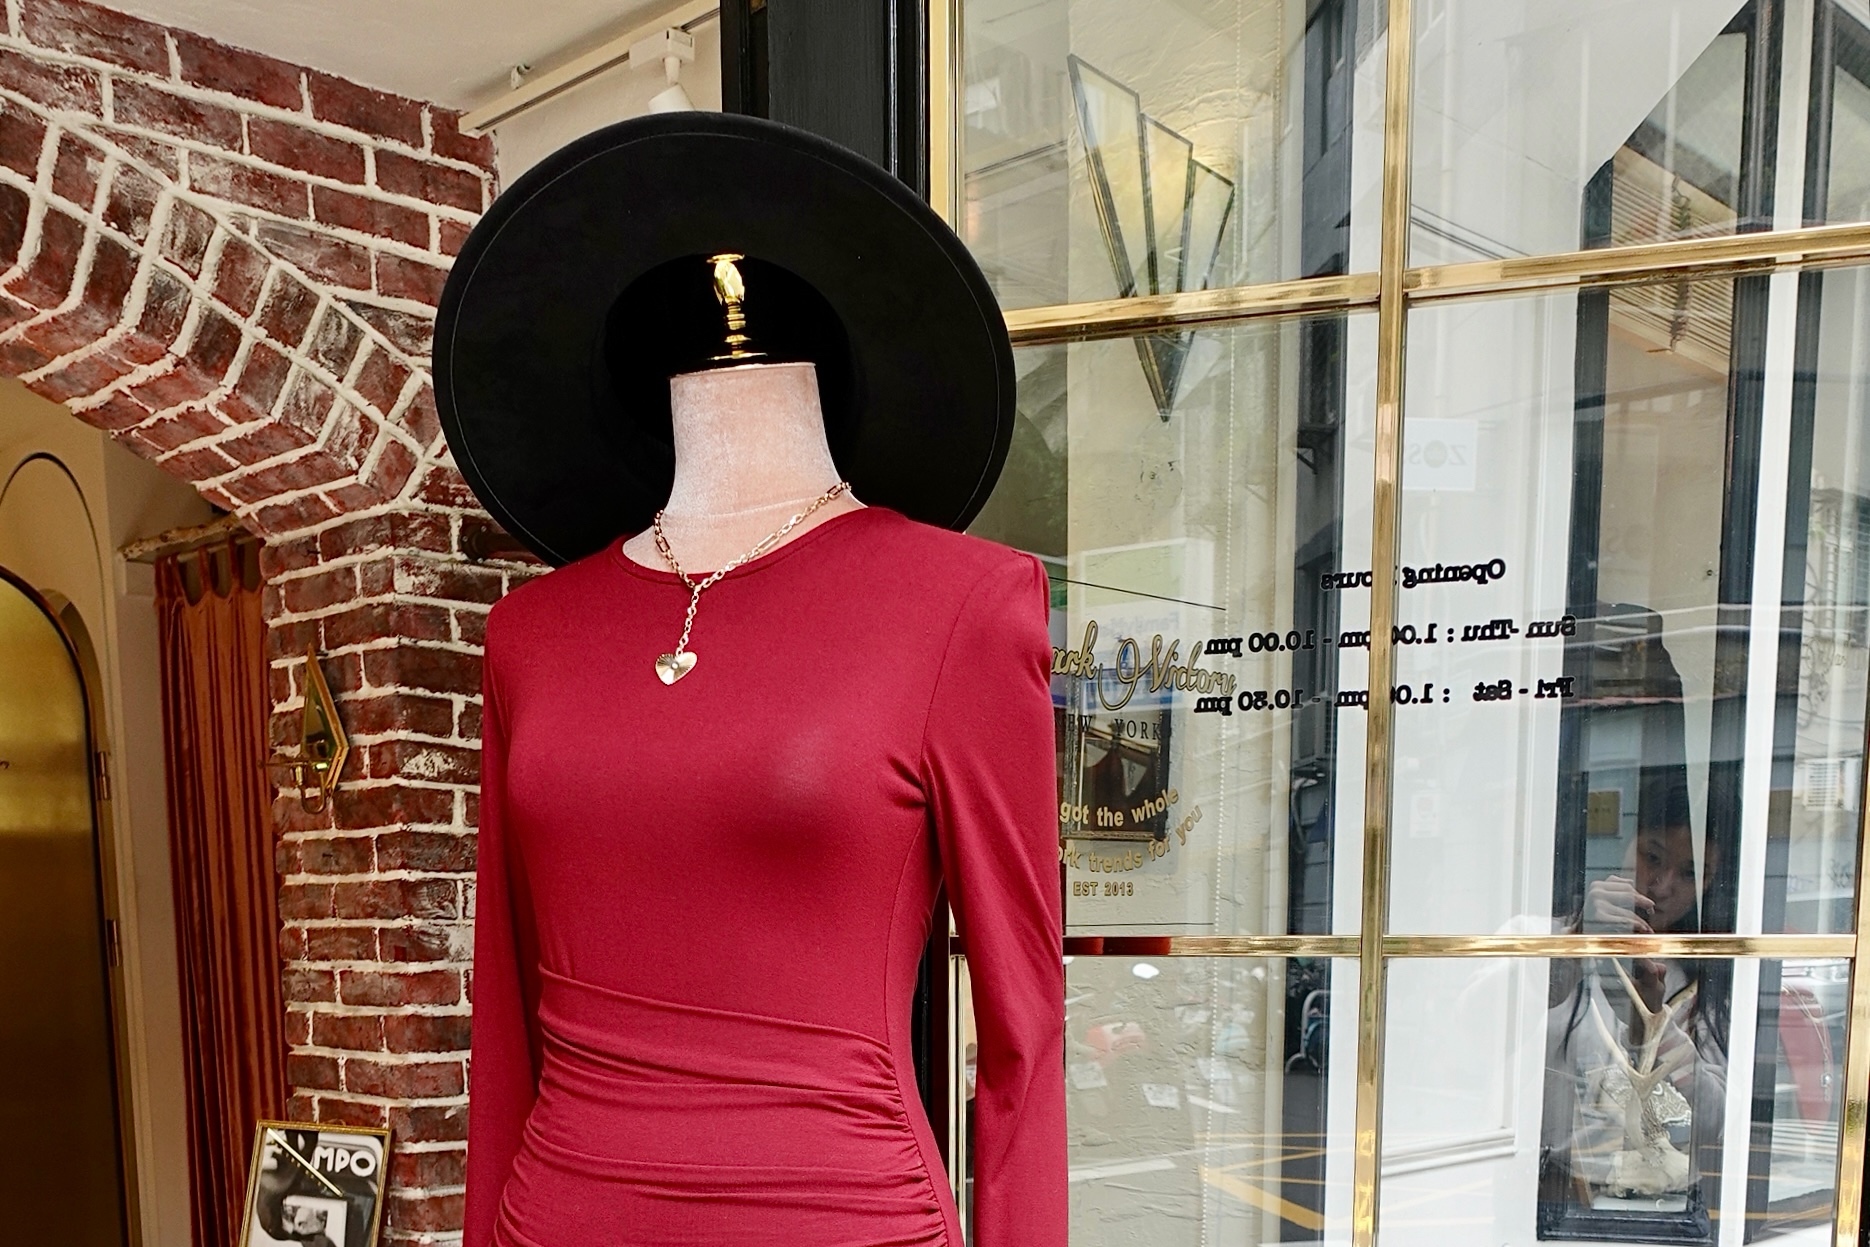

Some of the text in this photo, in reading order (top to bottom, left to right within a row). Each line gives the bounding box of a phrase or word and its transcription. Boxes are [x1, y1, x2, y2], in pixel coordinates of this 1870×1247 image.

[1051, 620, 1098, 680] ark
[1114, 718, 1163, 740] YORK
[1059, 788, 1179, 827] got the whole
[1088, 850, 1143, 873] trends
[1148, 837, 1171, 861] for
[1175, 805, 1203, 846] you
[1073, 881, 1134, 897] EST 2013
